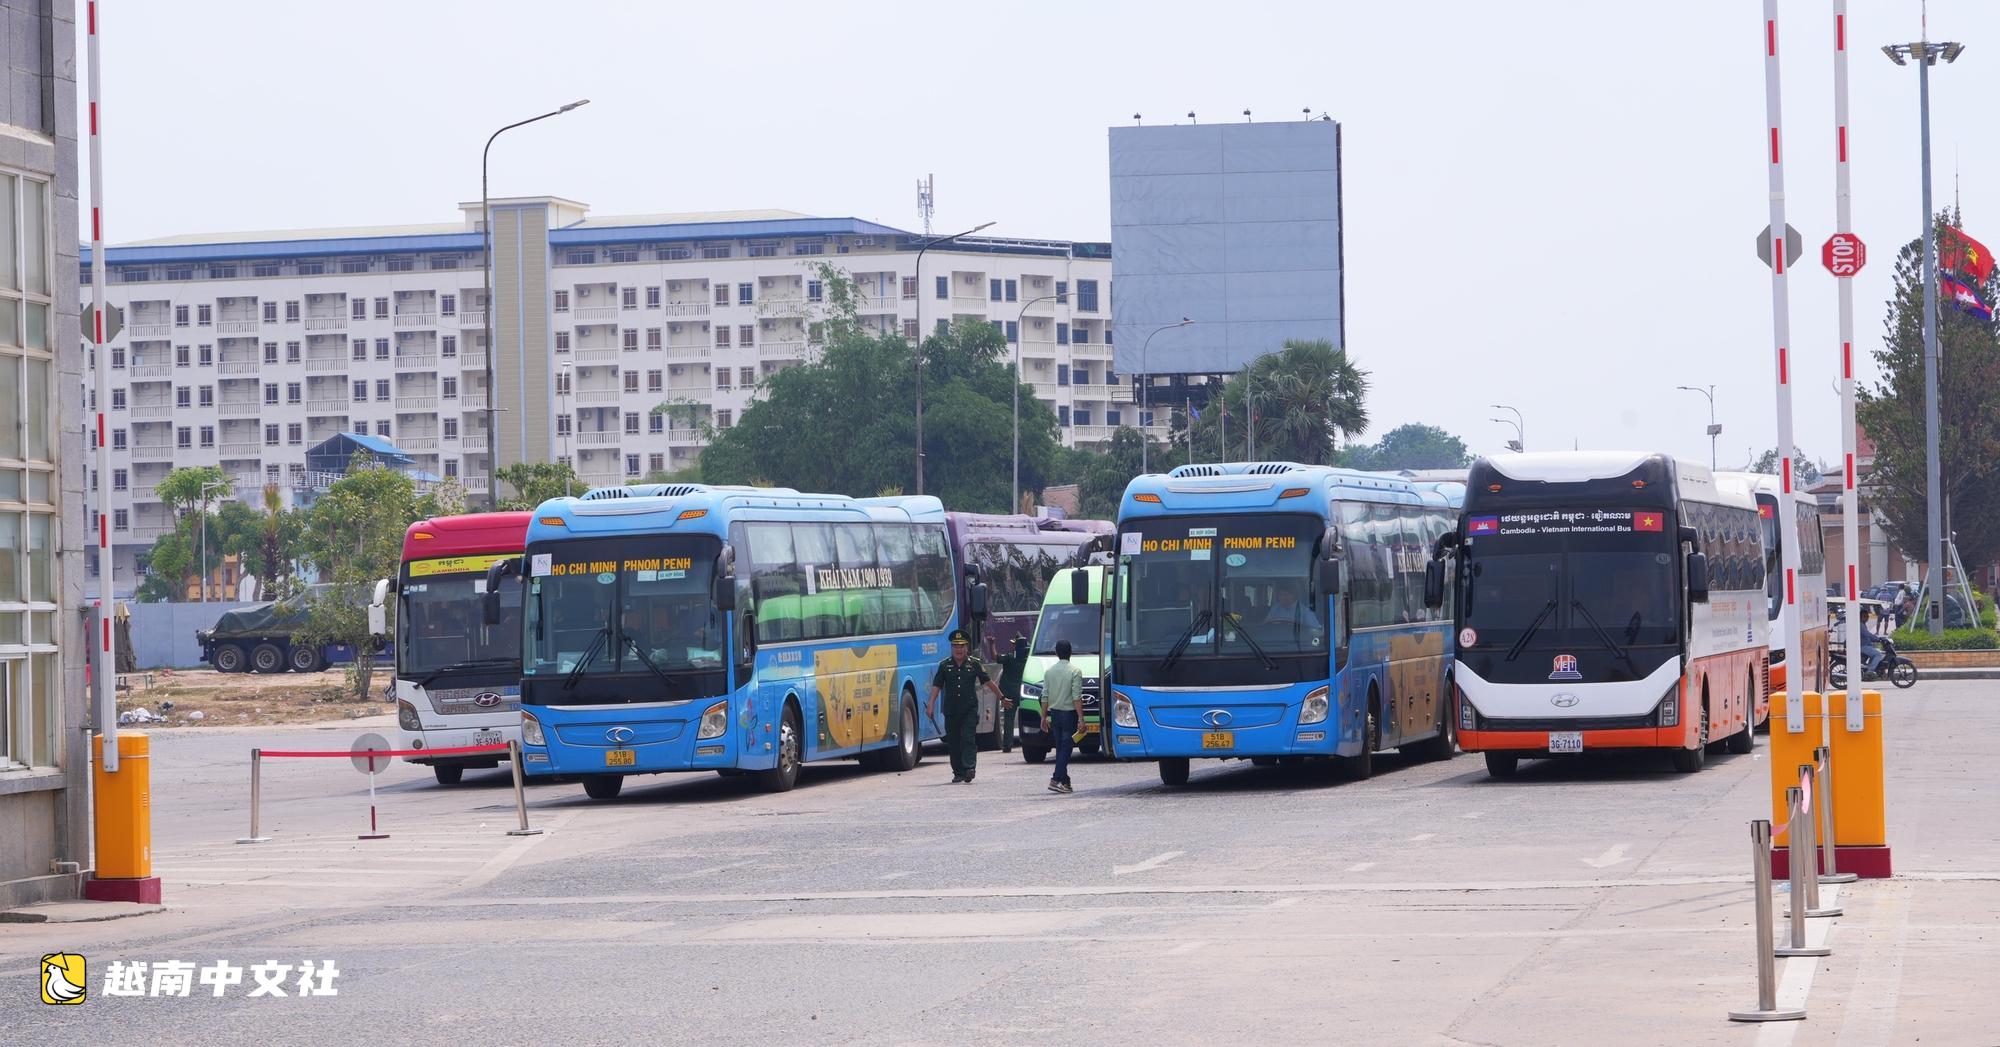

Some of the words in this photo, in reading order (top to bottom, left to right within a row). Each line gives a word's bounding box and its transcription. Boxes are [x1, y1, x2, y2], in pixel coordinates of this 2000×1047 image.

[1832, 236, 1855, 273] STOP
[1143, 540, 1158, 552] HO
[1161, 539, 1180, 551] CHI
[1183, 538, 1212, 550] MINH
[1224, 537, 1262, 549] PHNOM
[1265, 537, 1296, 549] PENH
[552, 564, 566, 576] HO
[568, 562, 587, 575] CHI
[589, 561, 617, 574] MINH
[624, 558, 660, 571] PHNOM
[663, 557, 691, 570] PENH
[819, 563, 841, 589] KHẢI
[840, 568, 861, 589] NAM
[861, 567, 877, 588] 1900
[877, 567, 892, 588] 1939
[1461, 632, 1476, 644] A28
[1554, 661, 1576, 669] VET
[440, 703, 470, 713] CAPITOL
[1210, 733, 1225, 741] 51B
[1551, 739, 1581, 749] 3G-7110
